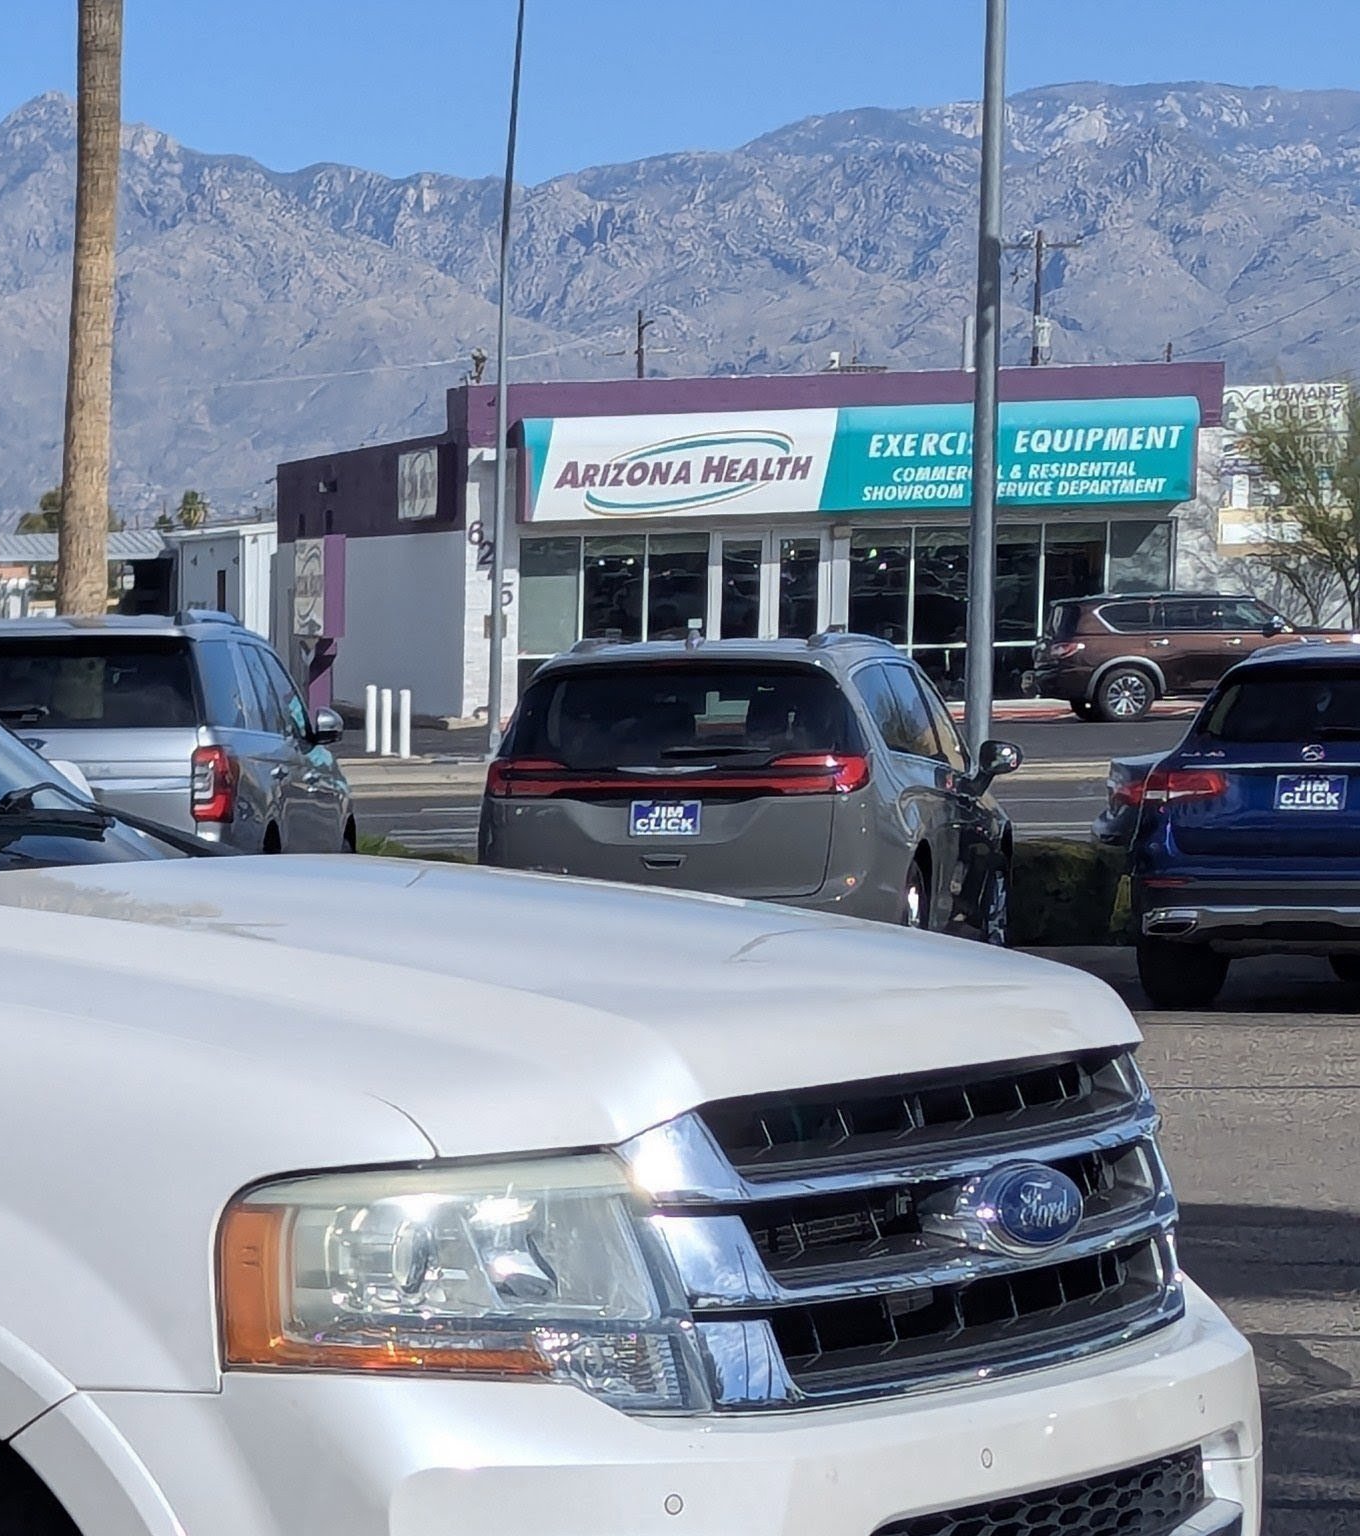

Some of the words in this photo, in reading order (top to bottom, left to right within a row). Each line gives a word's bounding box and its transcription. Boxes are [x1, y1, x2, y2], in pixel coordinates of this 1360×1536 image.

[868, 431, 974, 458] EXERCI
[1014, 425, 1185, 454] EQUIPMENT
[553, 460, 692, 489] ARIZONA
[700, 455, 813, 483] HEALTH
[1010, 464, 1022, 479] &
[1028, 460, 1137, 479] RESIDENTIAL
[862, 483, 965, 501] SHOWROOM
[995, 480, 1054, 498] ERVICE
[1056, 477, 1167, 496] DEPARTMENT
[1294, 780, 1330, 792] JIM
[1280, 792, 1340, 804] CLICK
[648, 806, 685, 818] JIM
[636, 818, 694, 831] CLICK
[1019, 1181, 1071, 1228] Ford
